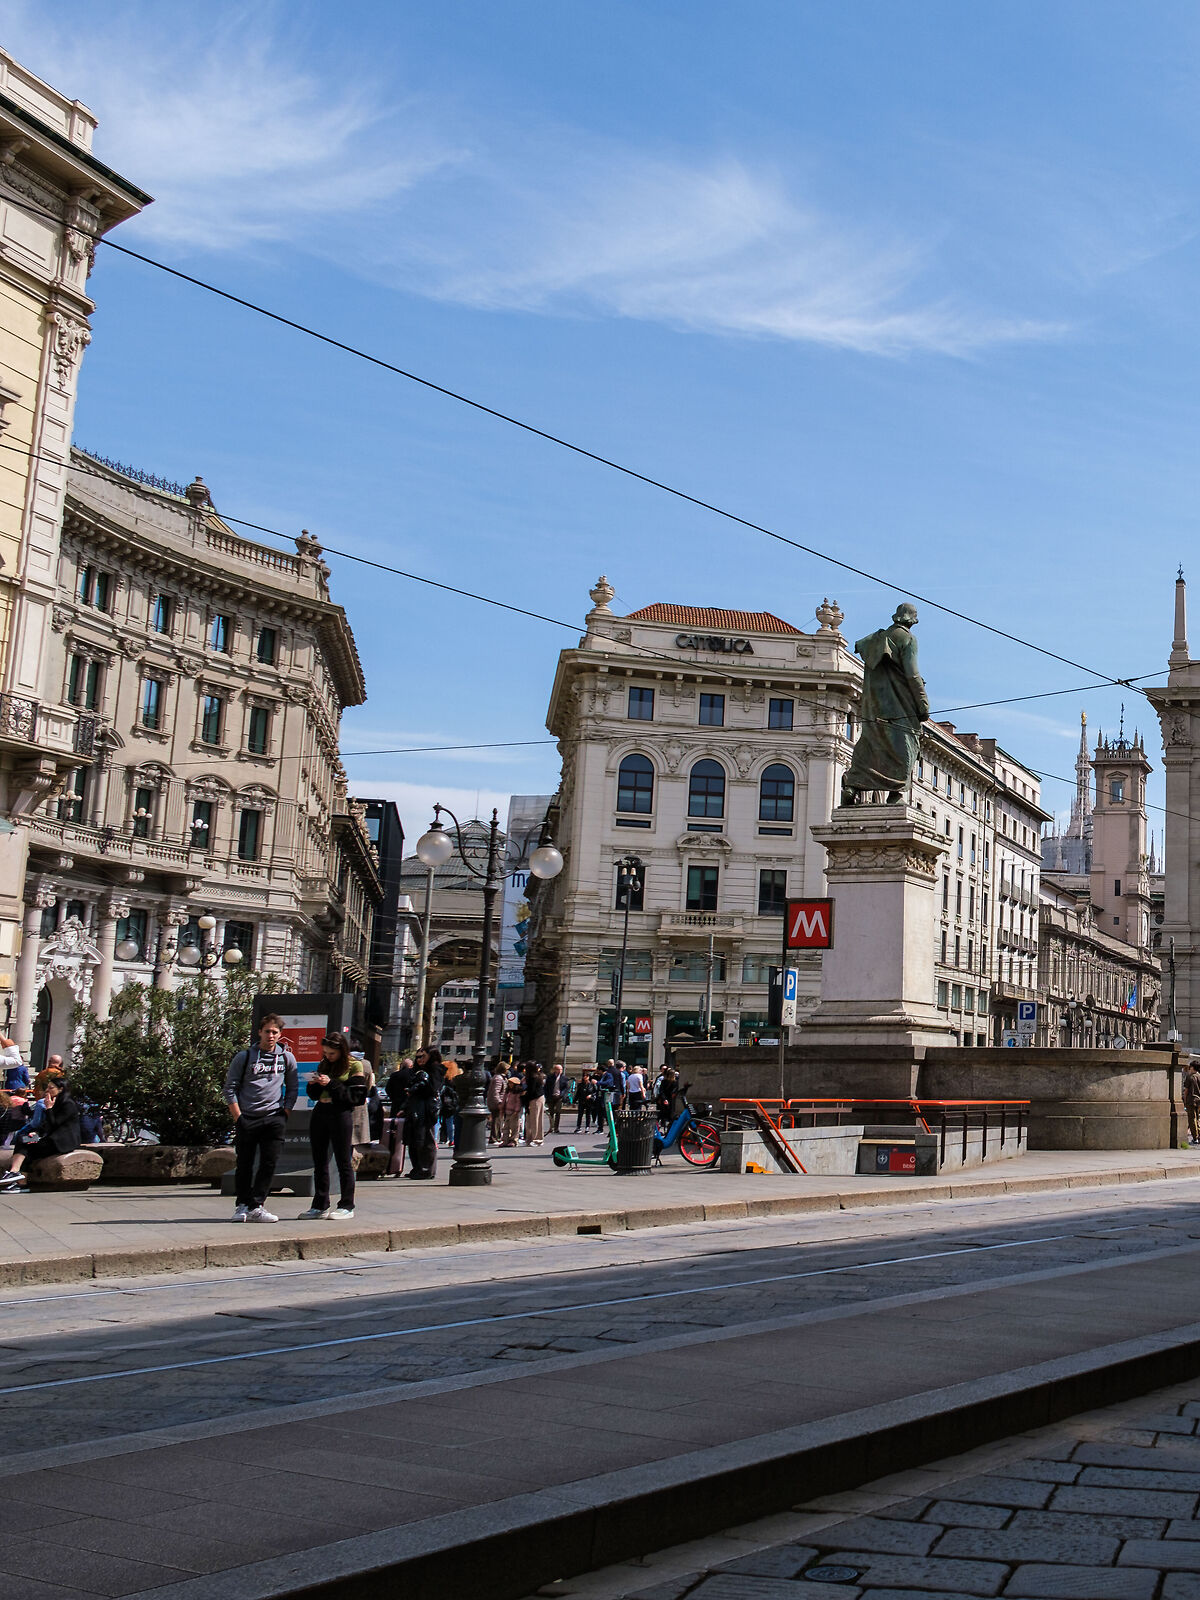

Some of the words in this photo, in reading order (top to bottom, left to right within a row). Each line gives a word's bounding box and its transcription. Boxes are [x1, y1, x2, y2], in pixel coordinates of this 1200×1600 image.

[675, 633, 755, 655] CATTOLICA
[791, 910, 827, 938] M
[786, 974, 795, 997] P
[1023, 1004, 1033, 1019] P
[637, 1020, 651, 1030] M
